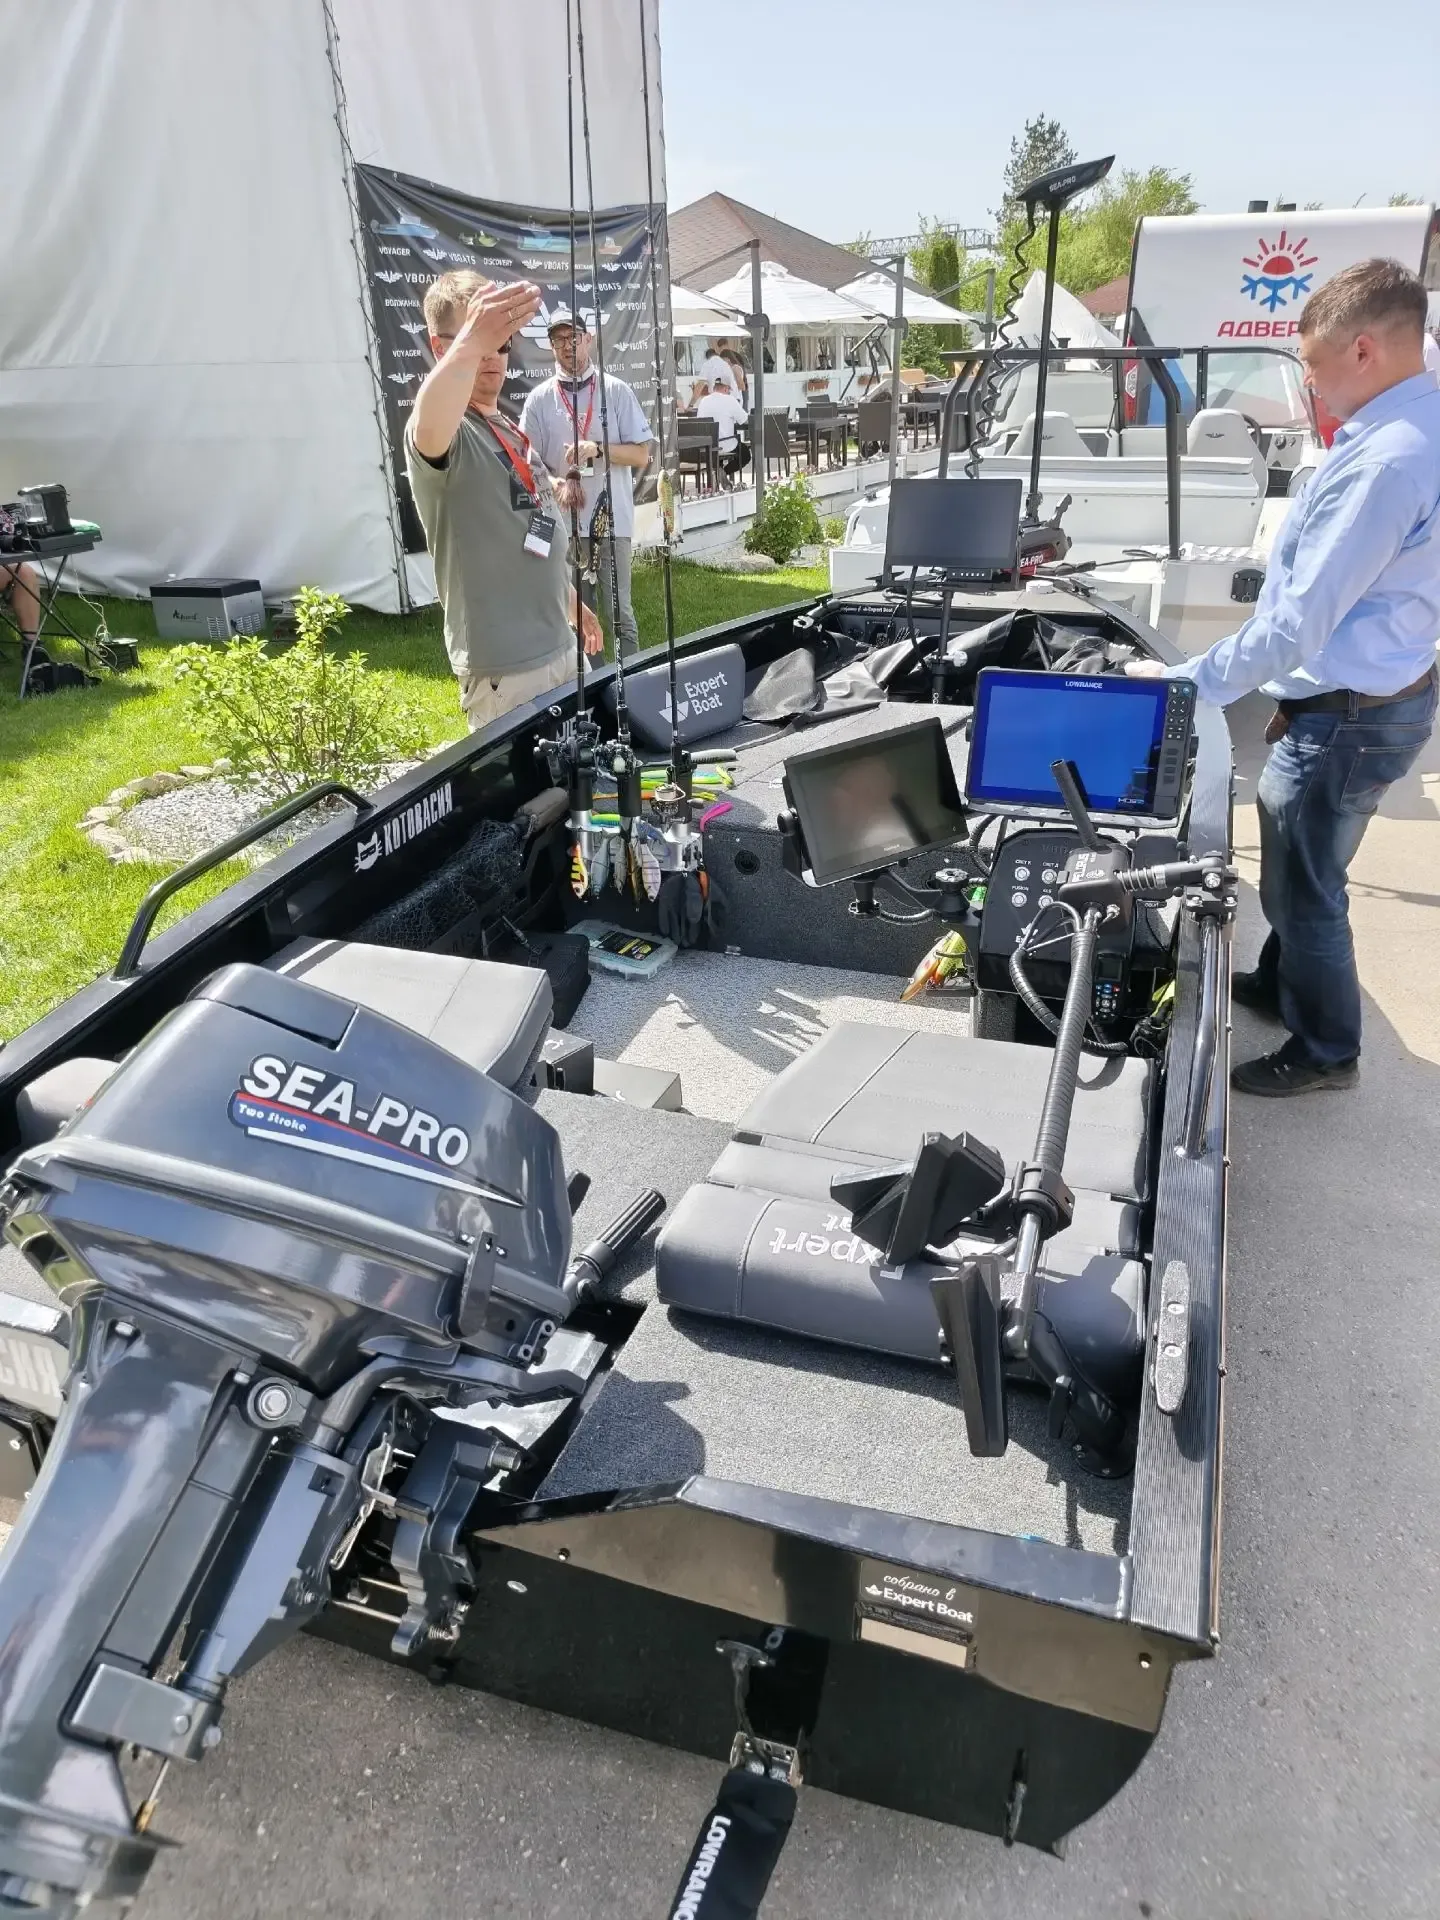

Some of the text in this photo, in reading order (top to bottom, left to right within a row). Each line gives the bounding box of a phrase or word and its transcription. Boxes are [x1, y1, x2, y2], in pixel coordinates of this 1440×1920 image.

[378, 246, 411, 256] VOYAGER
[448, 252, 477, 265] VBOATS
[543, 261, 569, 271] VBOATS
[598, 282, 622, 292] BOATS
[392, 350, 422, 358] VOYAGER
[525, 369, 553, 379] VBOATS
[1020, 553, 1044, 567] EA-PRO
[684, 671, 728, 699] Expert
[1065, 680, 1103, 689] LOWRANCE
[691, 693, 723, 716] Boat
[383, 782, 453, 856] КОТОВАСИЯ
[238, 1103, 307, 1132] Two Stroke
[243, 1057, 470, 1167] SEA-PRO
[883, 1574, 957, 1601] собрано в
[883, 1587, 974, 1623] Expert Boat
